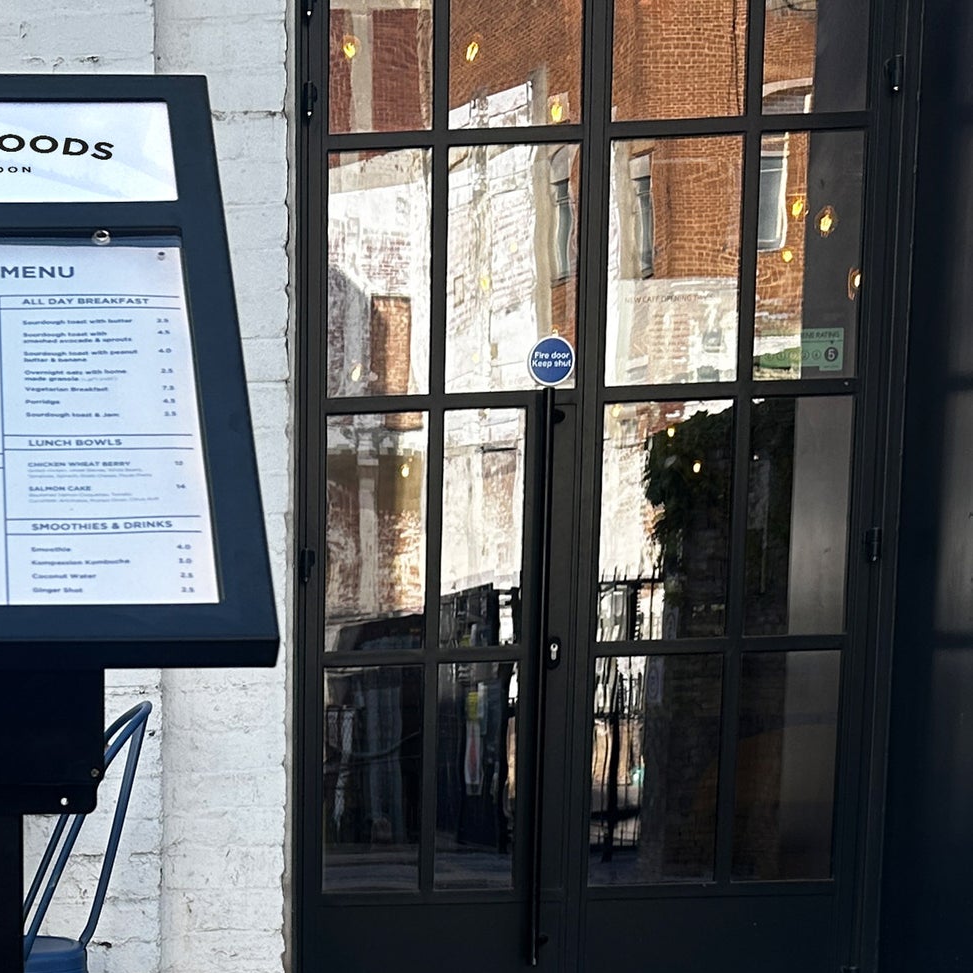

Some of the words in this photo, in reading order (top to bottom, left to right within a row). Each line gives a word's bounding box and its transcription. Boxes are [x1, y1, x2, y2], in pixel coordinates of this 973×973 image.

[1, 266, 74, 279] MENU
[532, 360, 552, 368] Keep
[32, 523, 107, 531] SMOOTHIES
[112, 522, 120, 530] &
[124, 521, 172, 529] DRINKS
